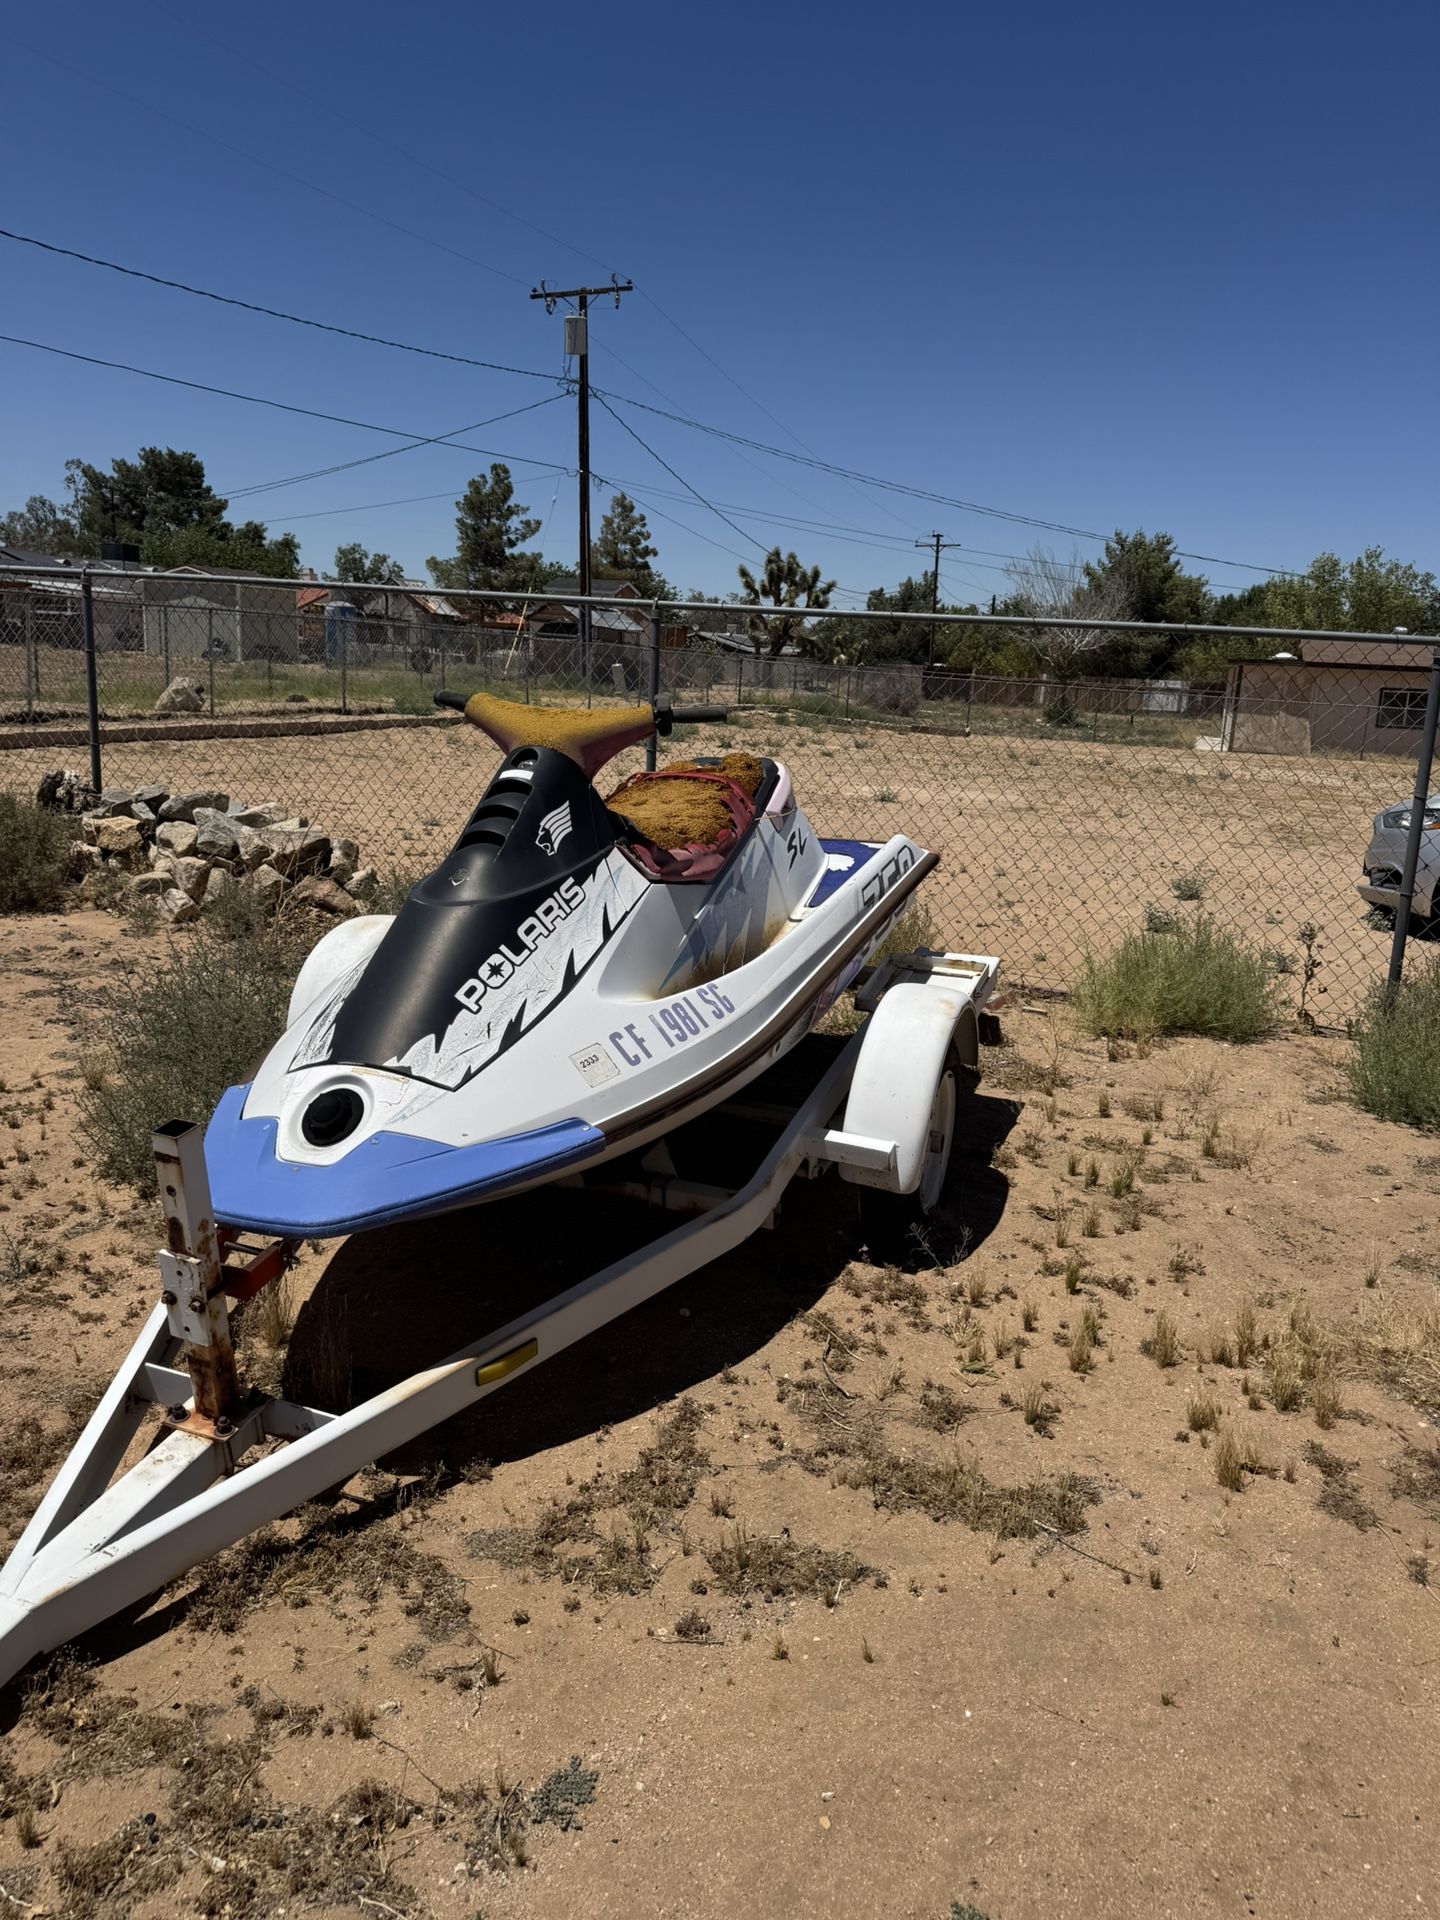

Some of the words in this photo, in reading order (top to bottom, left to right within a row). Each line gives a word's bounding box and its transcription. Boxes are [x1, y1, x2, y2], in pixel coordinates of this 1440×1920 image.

[786, 827, 808, 873] SL
[454, 876, 587, 1015] POLARIS
[608, 1023, 653, 1067] CF
[648, 996, 710, 1048] 1981
[579, 1054, 600, 1069] 2333
